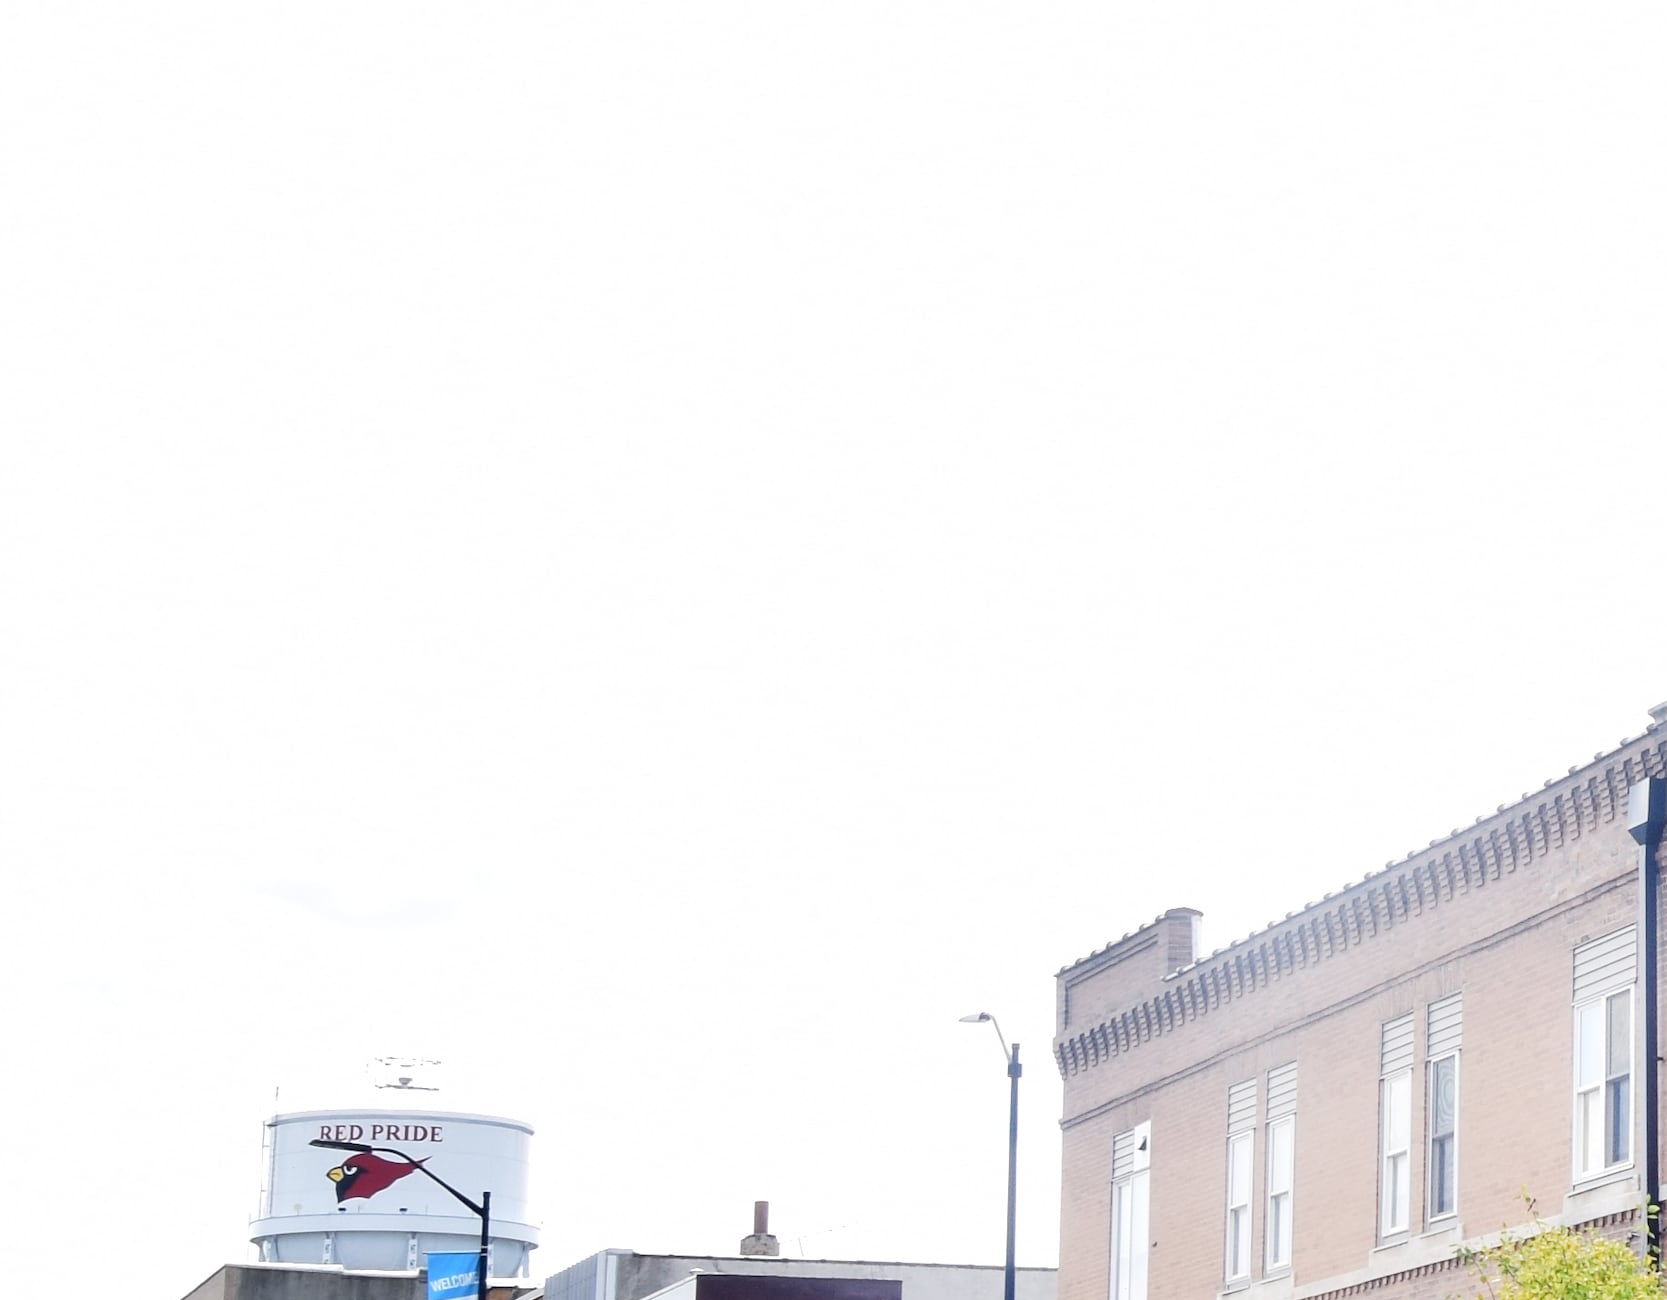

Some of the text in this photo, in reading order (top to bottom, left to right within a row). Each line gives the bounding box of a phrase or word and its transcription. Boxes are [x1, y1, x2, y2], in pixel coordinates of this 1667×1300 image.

[319, 1124, 443, 1142] RED PRIDE
[430, 1271, 480, 1292] WELCOME
